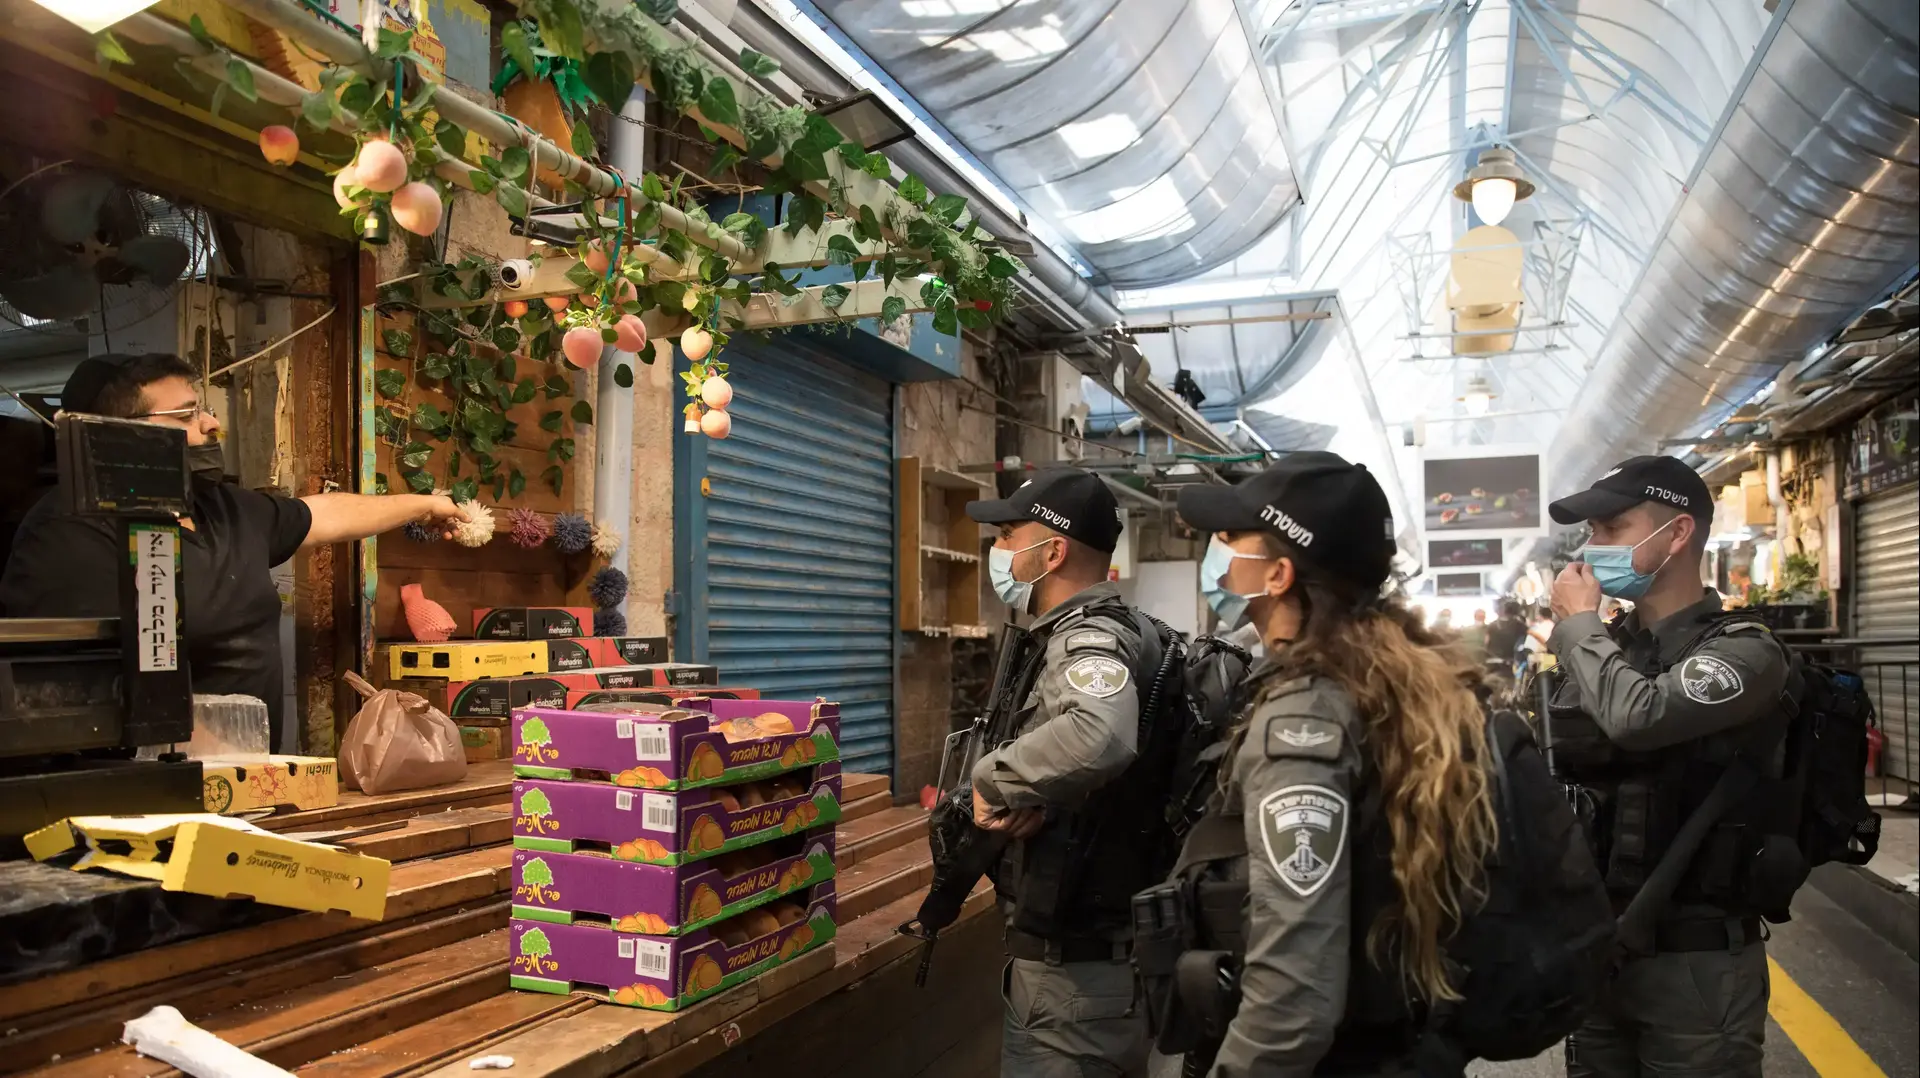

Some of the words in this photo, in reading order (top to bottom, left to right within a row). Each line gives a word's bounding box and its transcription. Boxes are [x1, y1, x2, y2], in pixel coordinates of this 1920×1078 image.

[1645, 486, 1689, 506] משטרה
[1031, 503, 1071, 529] משטרה
[1260, 504, 1314, 547] משטרה
[148, 533, 170, 559] אין
[548, 624, 573, 634] mehadrin
[558, 657, 583, 667] mehadrin
[543, 748, 559, 760] פרי
[306, 764, 332, 776] litchi
[543, 820, 560, 831] פרי
[304, 866, 351, 882] PROVIDENCIA
[544, 889, 561, 901] פרי
[542, 959, 559, 971] פרי
